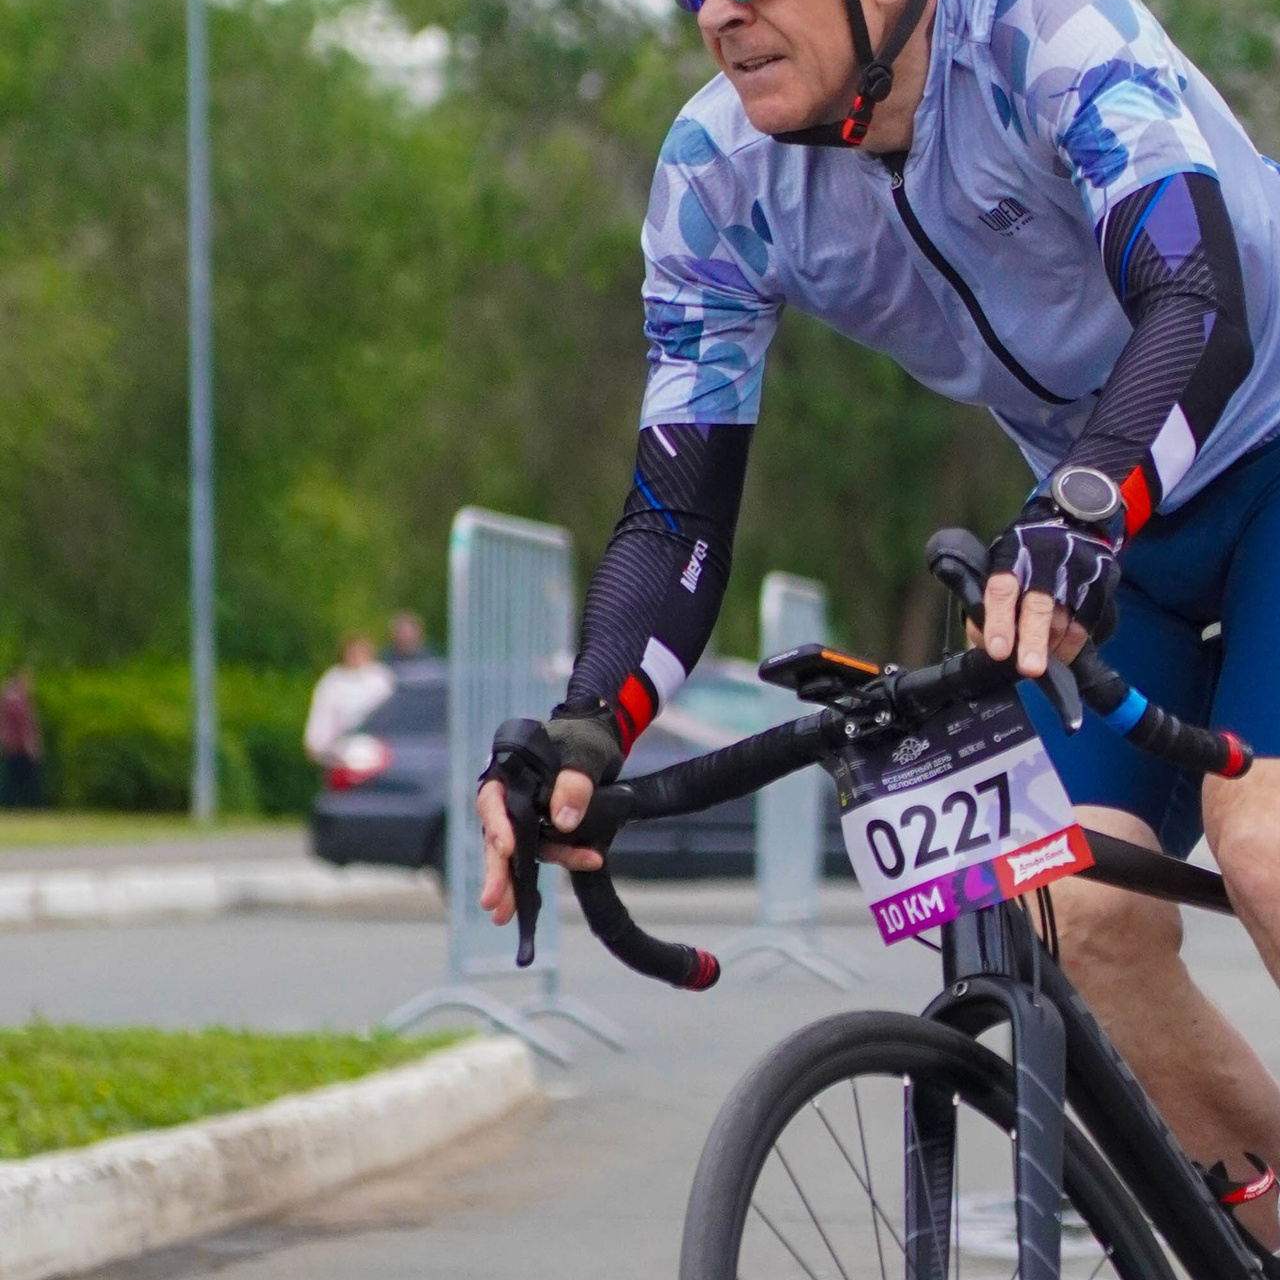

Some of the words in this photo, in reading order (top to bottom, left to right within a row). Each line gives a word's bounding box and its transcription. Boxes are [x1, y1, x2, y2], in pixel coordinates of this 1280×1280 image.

[881, 760, 934, 786] ВСЕМИРНЫЙ
[933, 754, 953, 771] ДЕНЬ
[887, 763, 954, 792] ВЕЛОСИПЕДИСТА
[866, 771, 1012, 881] 0227
[879, 905, 905, 935] 10
